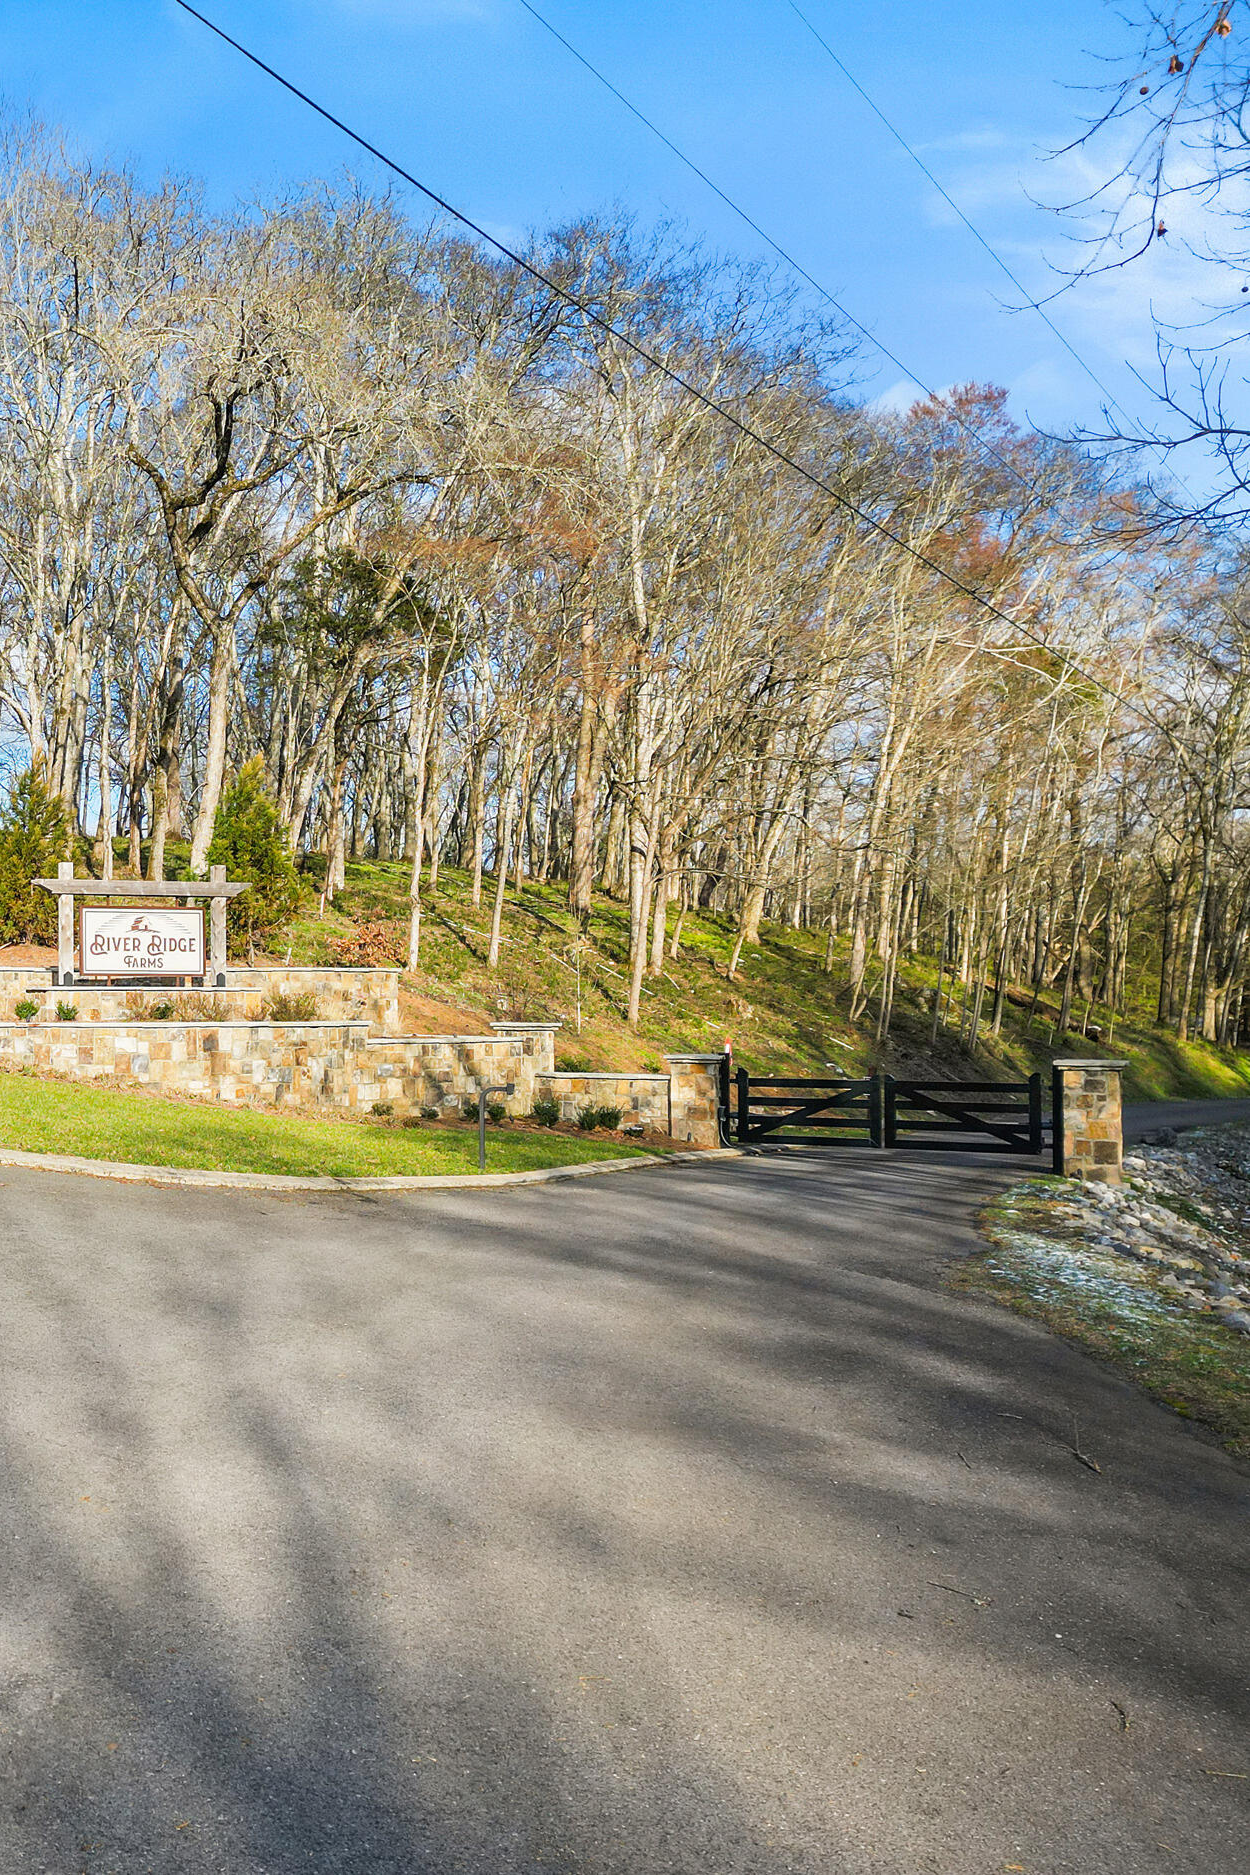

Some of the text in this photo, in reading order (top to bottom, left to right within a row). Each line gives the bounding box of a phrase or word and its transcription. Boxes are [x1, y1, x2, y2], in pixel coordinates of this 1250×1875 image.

[90, 934, 196, 956] RIVER RIDGE
[123, 955, 164, 969] FARMS
